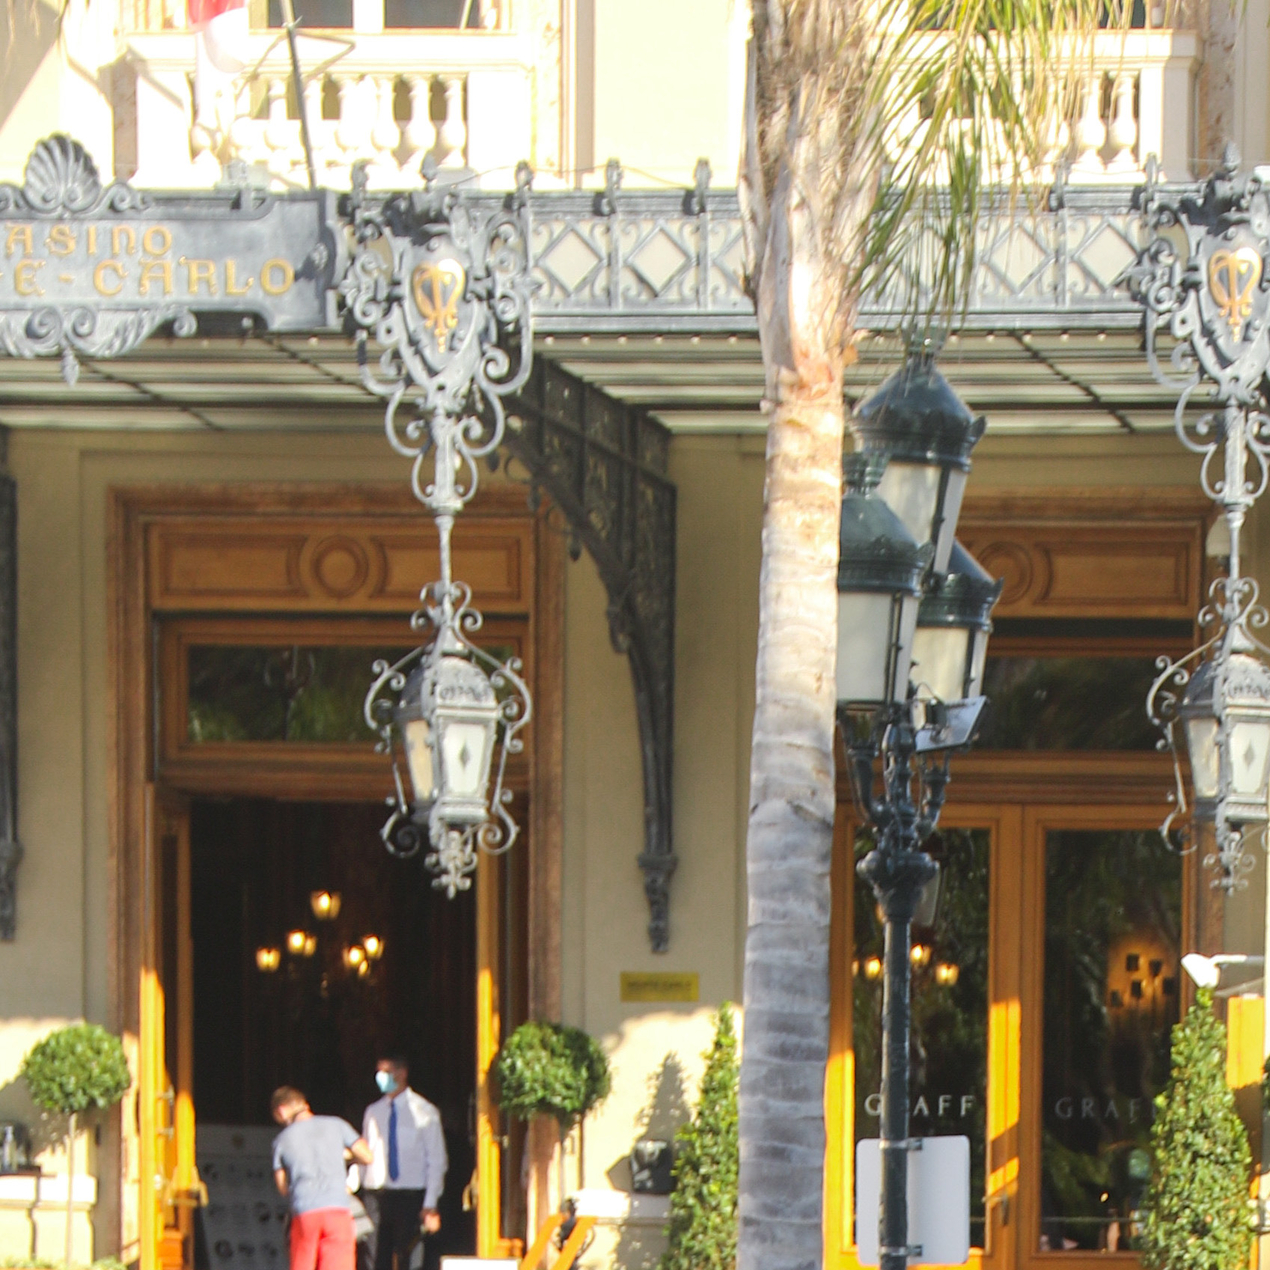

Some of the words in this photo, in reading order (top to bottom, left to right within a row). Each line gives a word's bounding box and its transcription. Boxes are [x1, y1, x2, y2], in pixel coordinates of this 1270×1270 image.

[3, 221, 173, 256] ASINO
[0, 255, 295, 297] E-CARLO
[864, 1094, 974, 1117] GAFF
